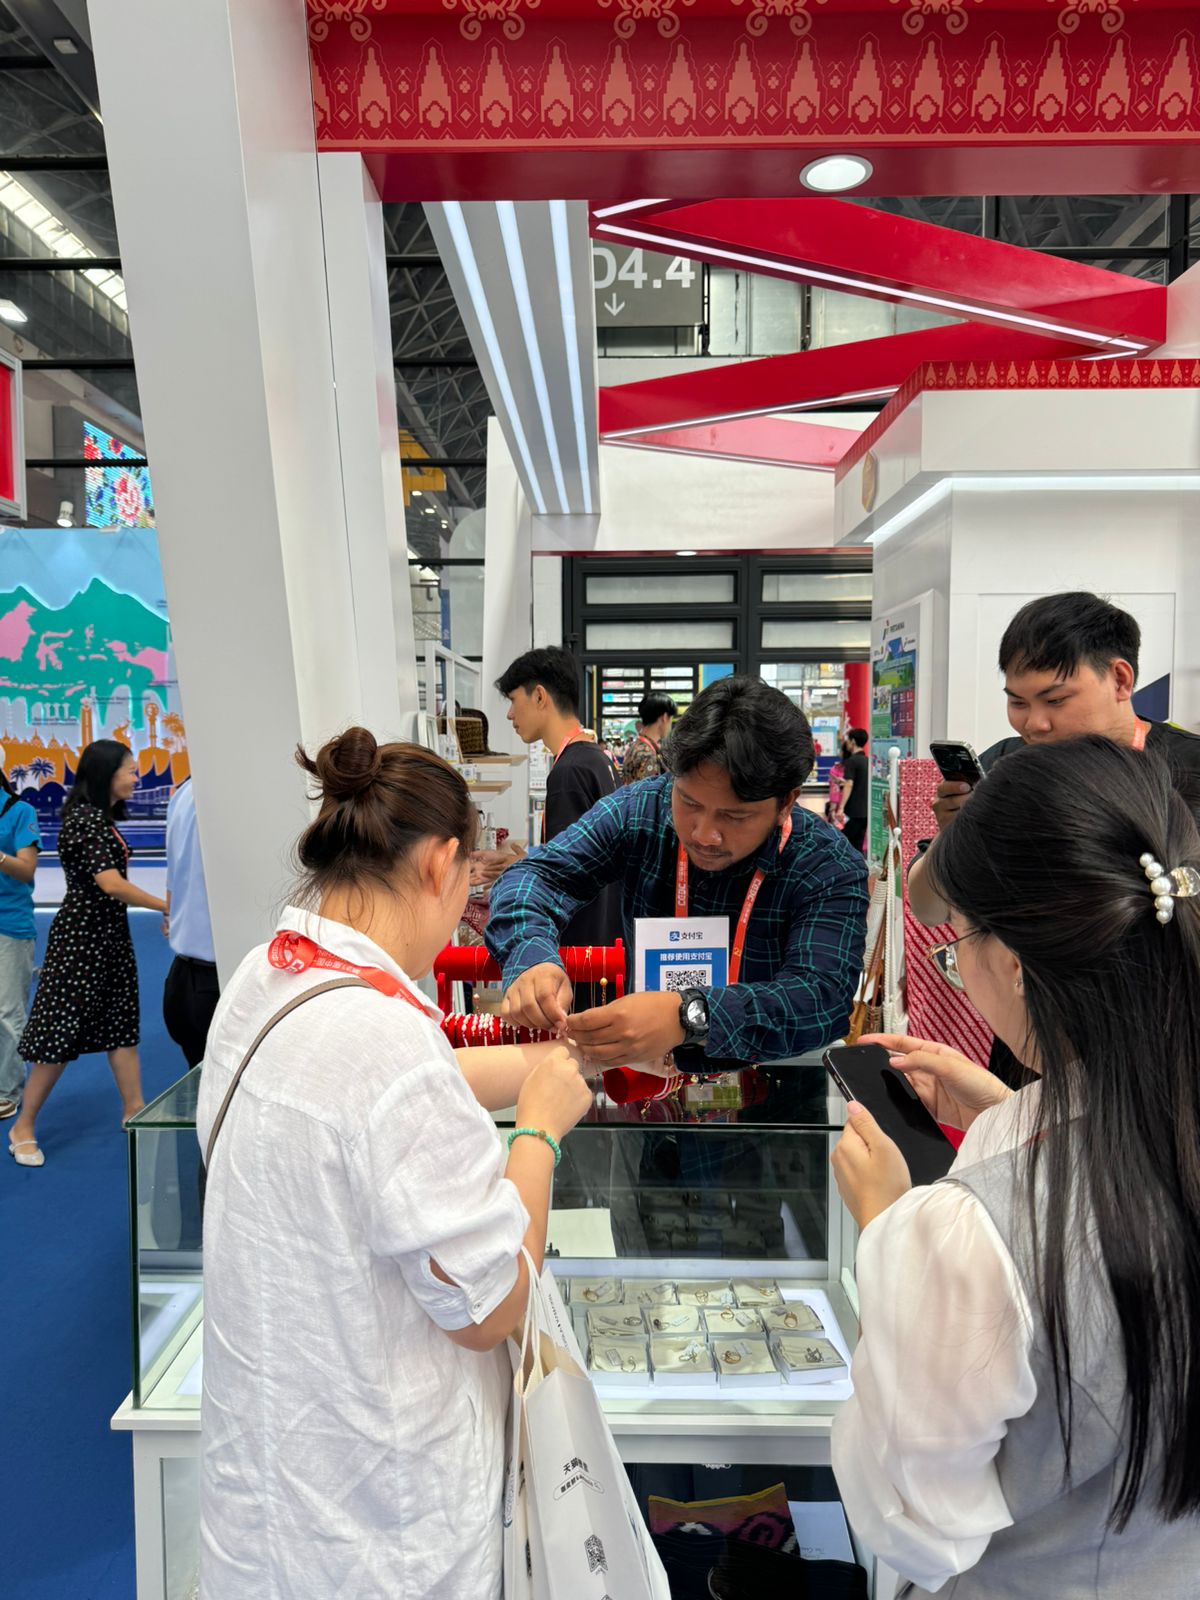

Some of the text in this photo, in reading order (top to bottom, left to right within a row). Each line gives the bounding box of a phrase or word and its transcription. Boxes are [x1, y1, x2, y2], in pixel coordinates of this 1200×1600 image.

[593, 247, 695, 289] D4.4
[681, 931, 703, 940] 支付宝
[660, 952, 712, 960] 推荐使用支付宝
